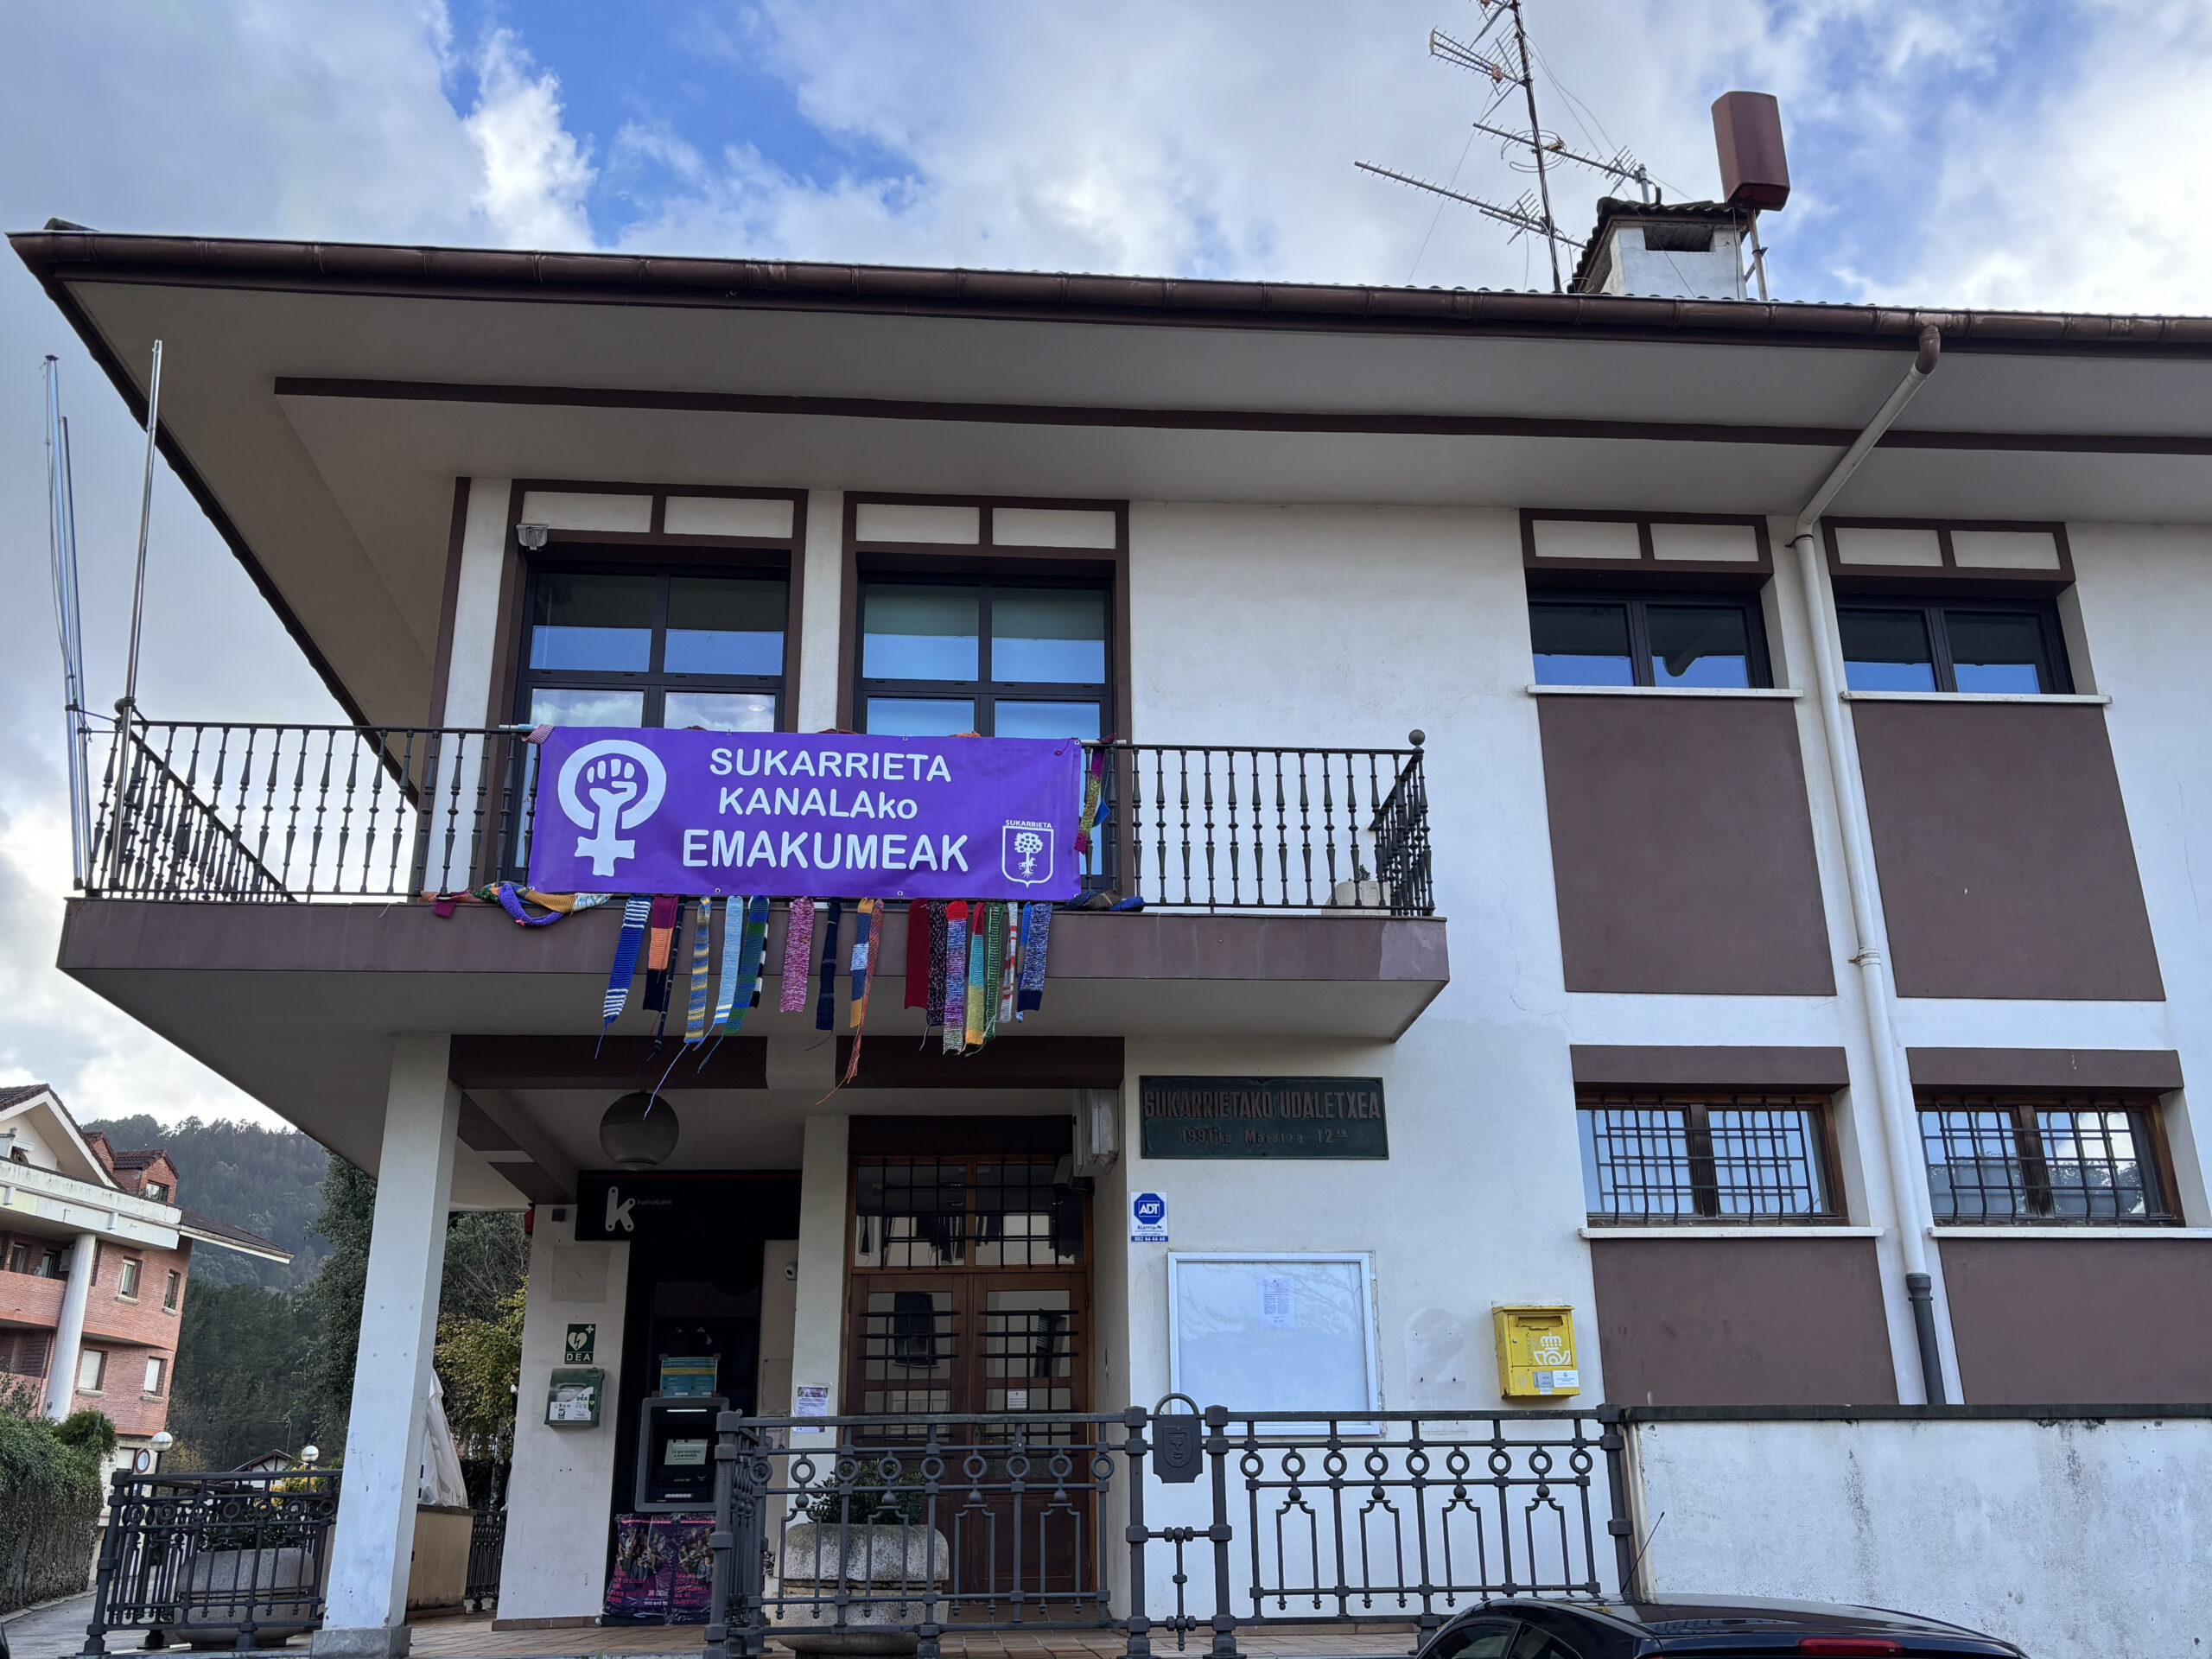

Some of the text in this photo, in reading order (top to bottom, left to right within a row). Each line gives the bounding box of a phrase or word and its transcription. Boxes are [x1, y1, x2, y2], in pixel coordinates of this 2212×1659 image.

[709, 747, 951, 782] SUKARRIETA
[719, 787, 918, 820] KANALAko
[1005, 819, 1052, 829] SUKARRIETA
[683, 830, 969, 873] EMAKUMEAK
[1144, 1090, 1381, 1120] SUKARRIETAKO UDALETXEA
[1139, 1203, 1160, 1215] ADT
[566, 1353, 591, 1362] DEA
